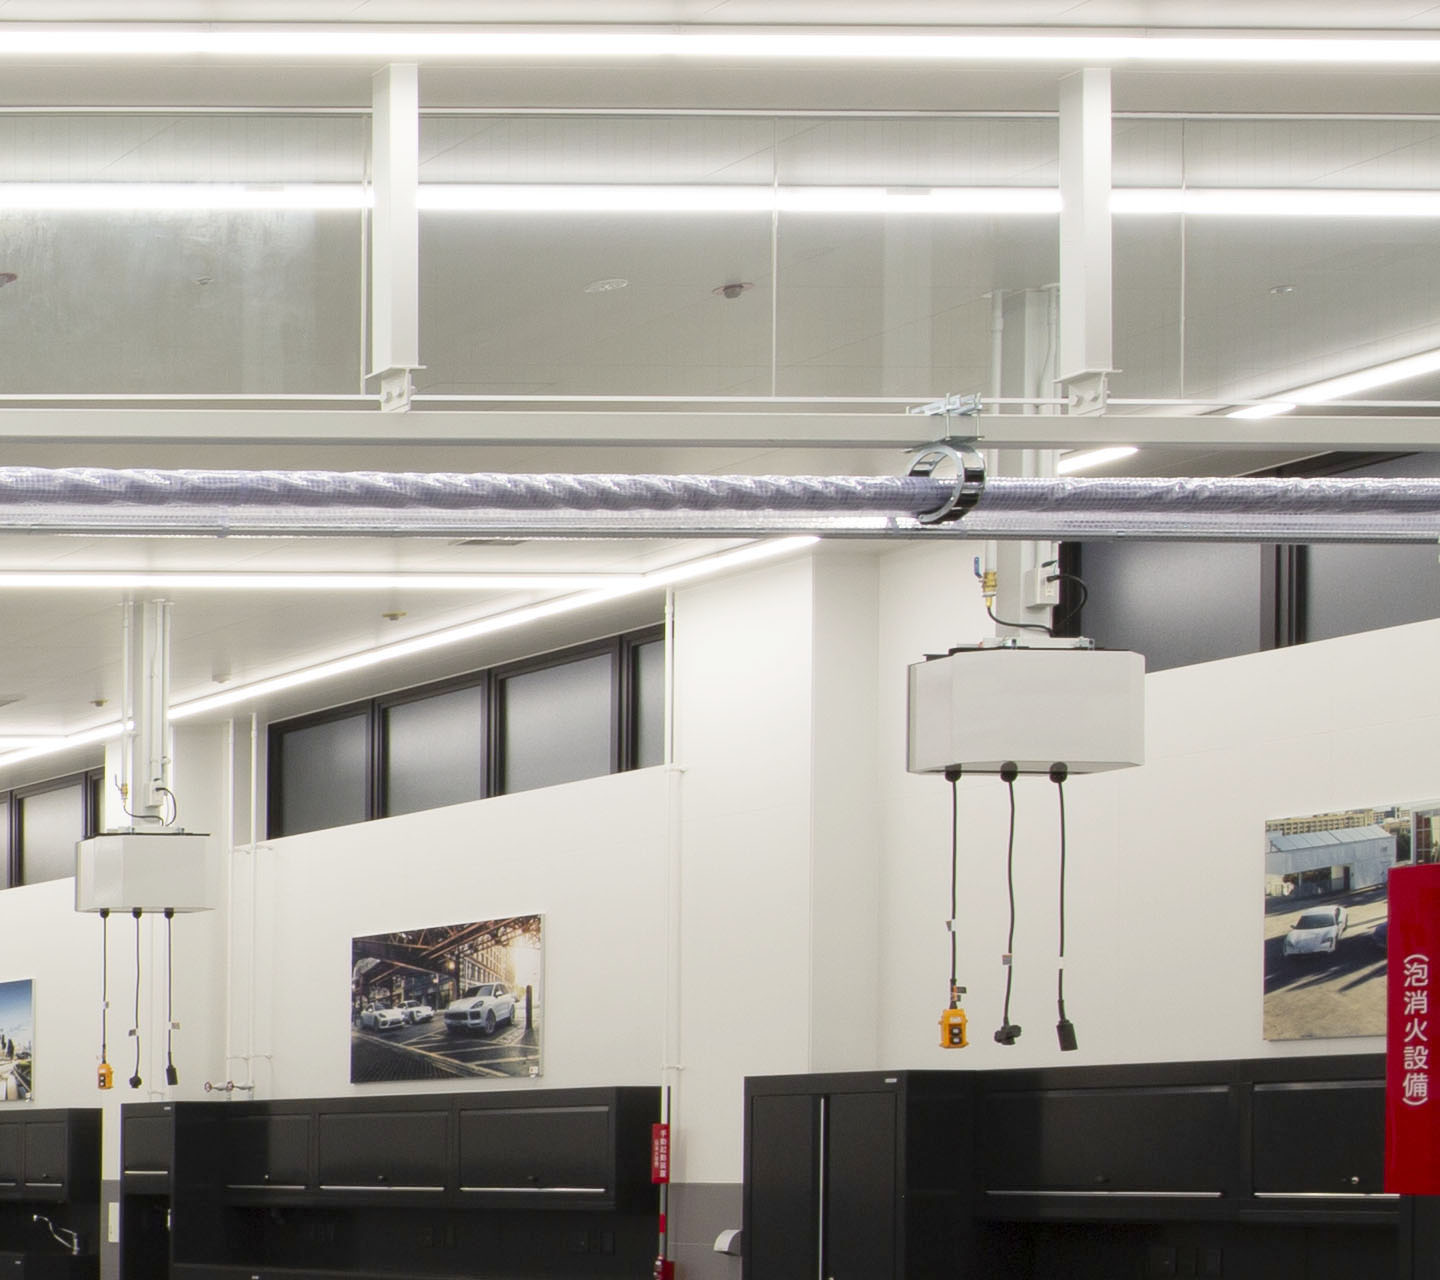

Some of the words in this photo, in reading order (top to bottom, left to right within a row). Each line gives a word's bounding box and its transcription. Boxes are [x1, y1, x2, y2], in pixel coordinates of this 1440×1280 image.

[1402, 954, 1429, 1106] （泡消火設備）
